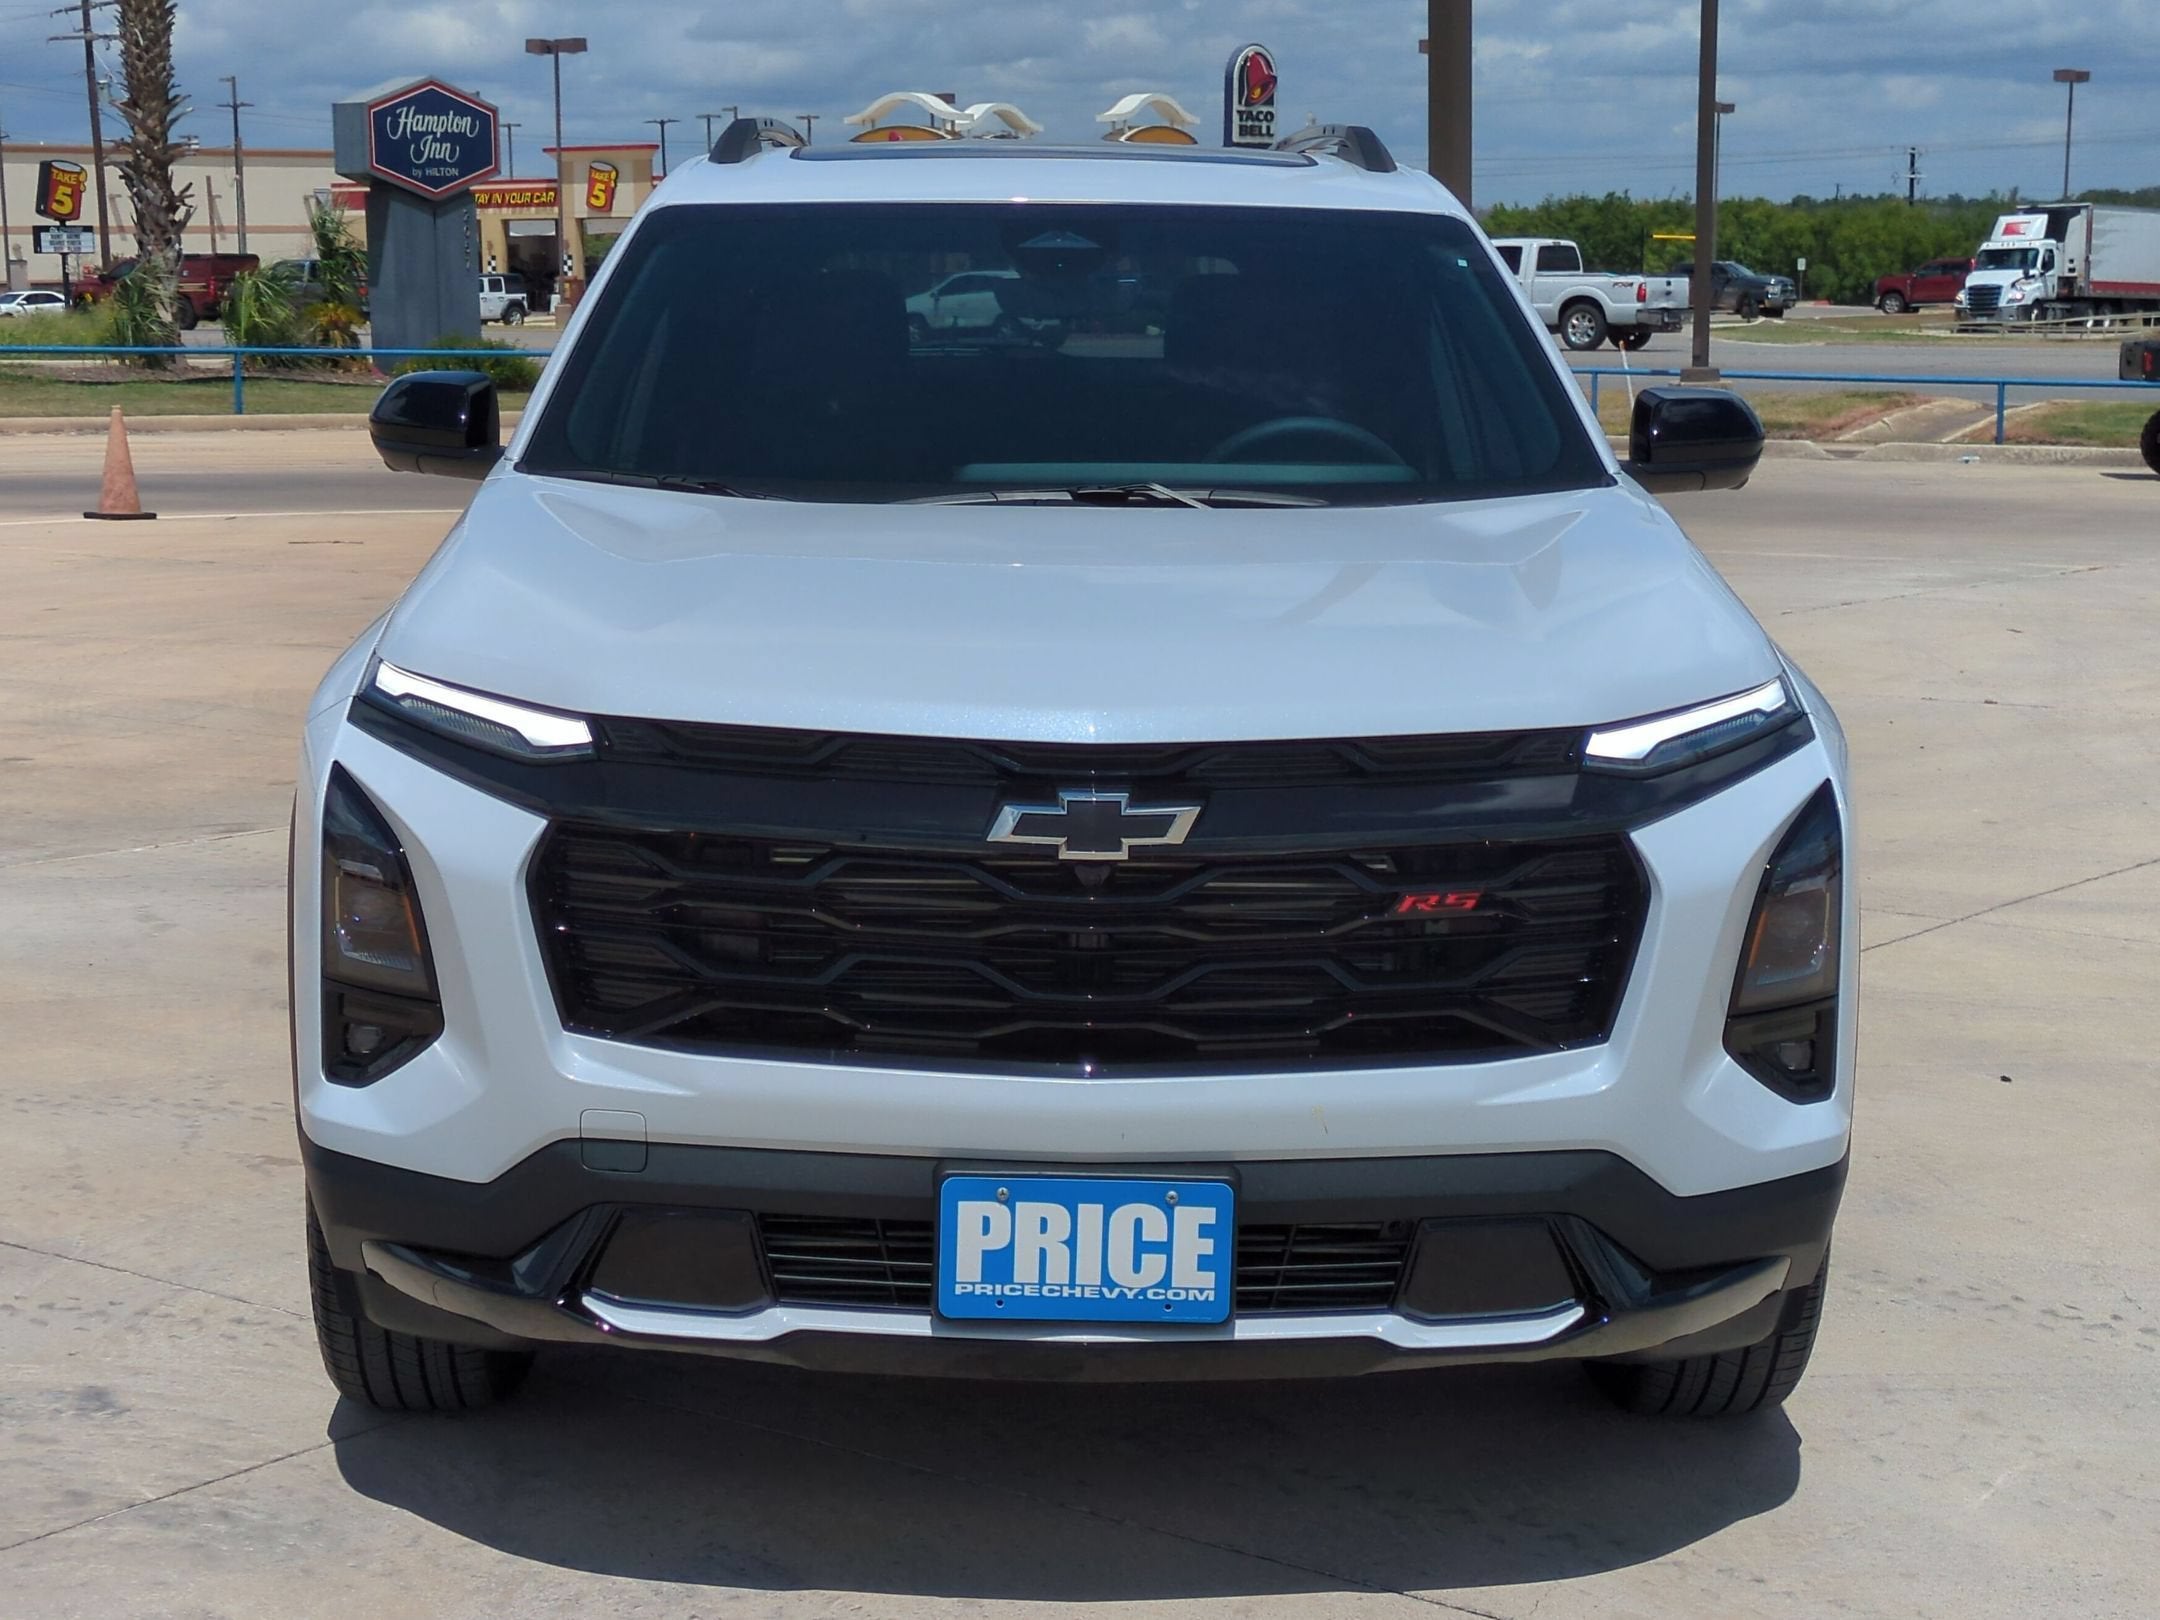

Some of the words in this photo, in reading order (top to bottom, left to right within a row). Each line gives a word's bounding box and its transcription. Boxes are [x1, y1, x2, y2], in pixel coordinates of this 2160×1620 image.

[386, 104, 480, 140] Hampton
[1236, 110, 1275, 122] TACO
[1238, 124, 1274, 137] BELL
[410, 134, 460, 164] Inn
[51, 168, 77, 184] TAKE
[412, 167, 422, 178] by
[425, 167, 459, 177] HILTON
[51, 185, 73, 214] 5
[474, 193, 490, 205] TAY
[491, 192, 503, 205] IN
[504, 192, 532, 204] YOUR
[533, 191, 555, 203] CAR
[590, 182, 607, 208] 5
[1397, 892, 1480, 913] RS
[955, 1200, 1217, 1289] PRICE
[954, 1283, 1215, 1303] PRICECHEVY.COM
